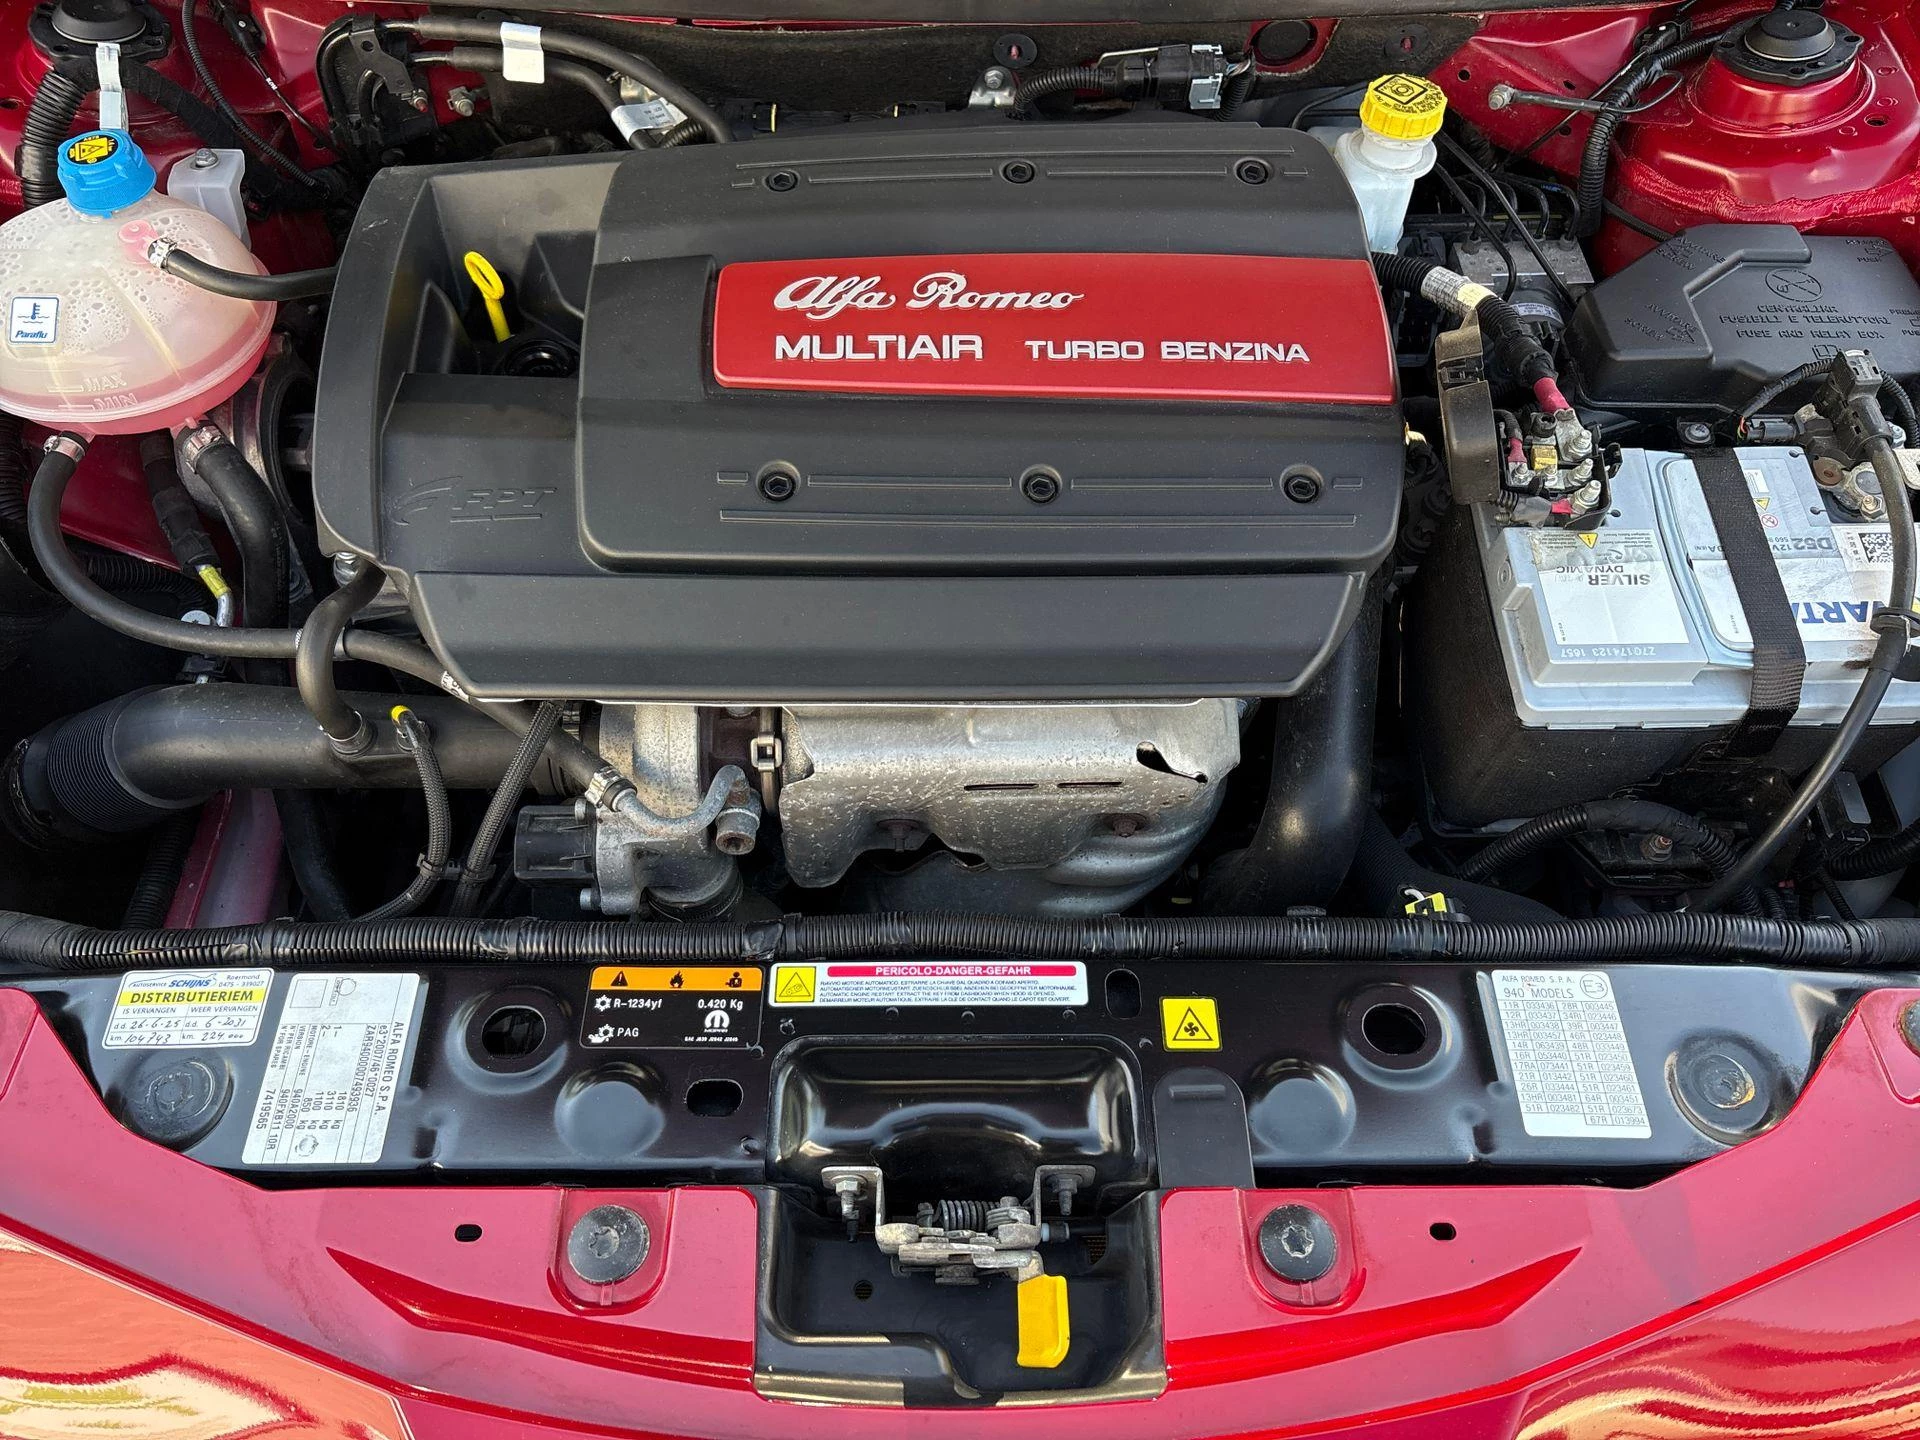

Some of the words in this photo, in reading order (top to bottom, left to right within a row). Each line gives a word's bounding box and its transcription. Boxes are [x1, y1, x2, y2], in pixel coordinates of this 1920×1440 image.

[774, 276, 896, 319] Alfa
[906, 272, 1084, 310] Romeo
[15, 330, 48, 338] Paraflu
[1736, 330, 1773, 338] FUSE
[1859, 330, 1885, 339] BOX
[776, 335, 983, 362] MULTIAIR
[1026, 340, 1144, 361] TURBO
[1162, 341, 1310, 362] BENZINA
[84, 374, 127, 391] MAX
[94, 392, 138, 410] MIN
[1557, 565, 1624, 574] DYNAMIC
[1588, 574, 1650, 585] SILVER
[1791, 600, 1886, 624] ART
[876, 966, 1031, 976] PERICOLO-DANGER-GEFAHR
[130, 991, 253, 1004] DISTRIBUTIERIEM
[1504, 988, 1524, 998] 940
[1531, 988, 1574, 999] MODELS
[614, 999, 662, 1010] R-1234yf
[698, 999, 726, 1008] 0.420
[730, 999, 743, 1011] Kg
[390, 1022, 404, 1045] ALFA
[617, 1028, 639, 1037] PAG
[382, 1049, 399, 1081] ROMEO
[301, 1098, 312, 1112] 850
[312, 1092, 324, 1110] 1100
[324, 1091, 336, 1110] 3110
[335, 1092, 347, 1110] 1810
[296, 1120, 307, 1130] kg
[308, 1120, 319, 1130] kg
[320, 1120, 330, 1130] kg
[331, 1120, 342, 1130] kg
